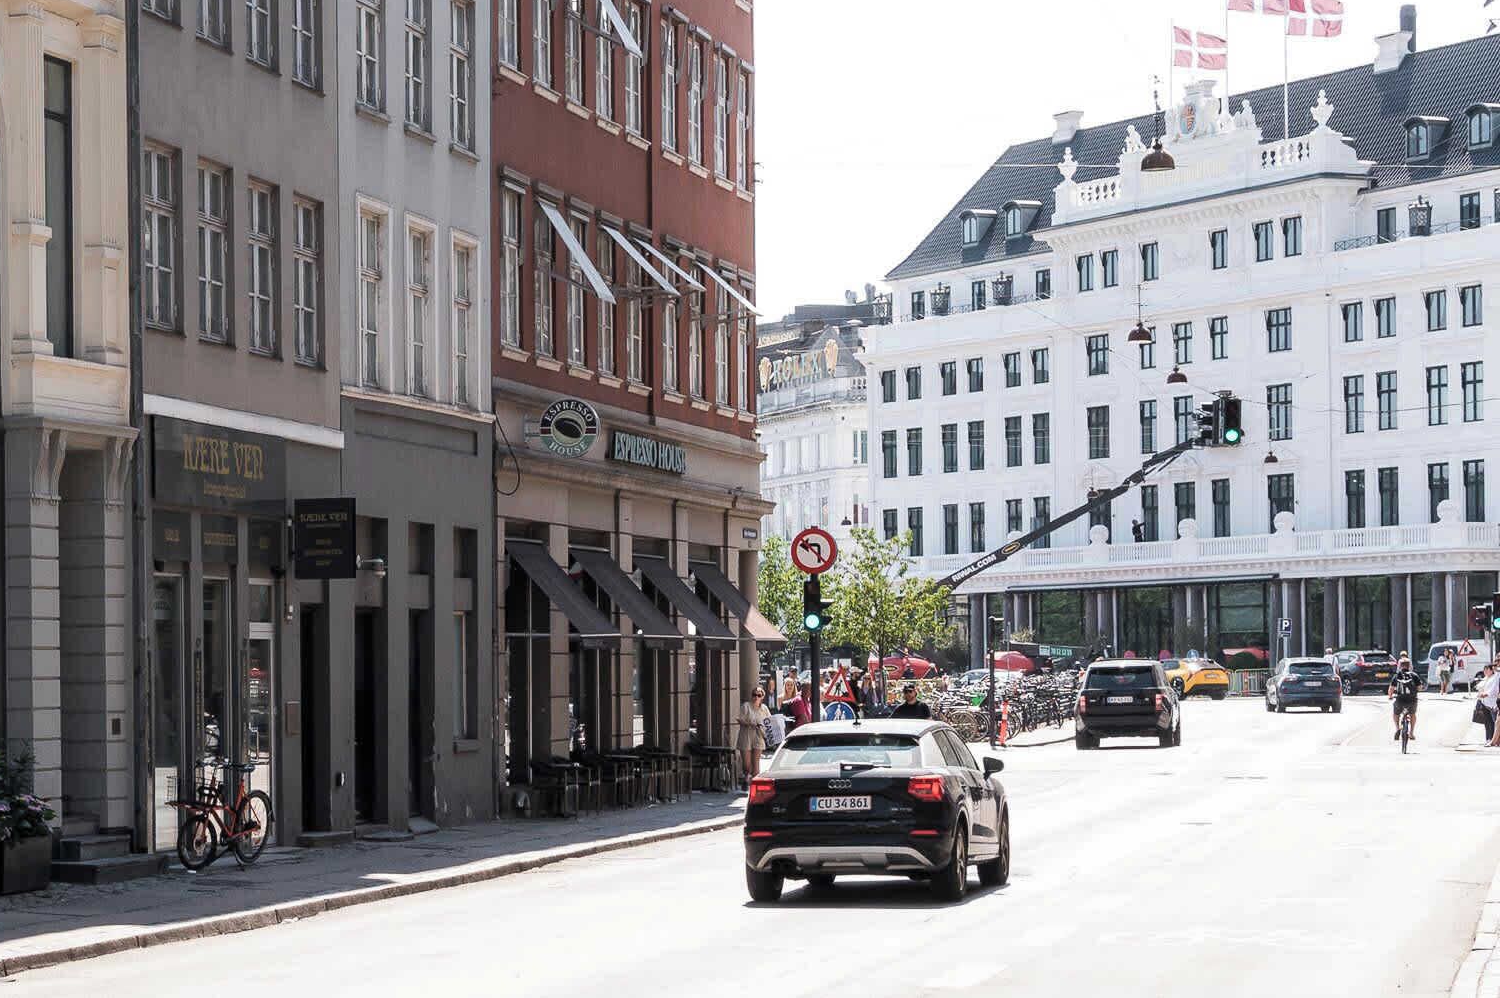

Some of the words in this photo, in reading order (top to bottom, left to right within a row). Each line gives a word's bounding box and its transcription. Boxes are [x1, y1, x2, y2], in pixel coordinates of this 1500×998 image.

[544, 401, 594, 422] ESPRESSO
[549, 441, 588, 456] HOUSE
[614, 431, 657, 467] ESPRESSO
[658, 441, 686, 474] HOUSE
[951, 553, 997, 582] RIWAL.COM
[1282, 620, 1290, 629] P
[817, 799, 832, 809] CU
[834, 799, 847, 808] 34
[850, 799, 869, 808] 861
